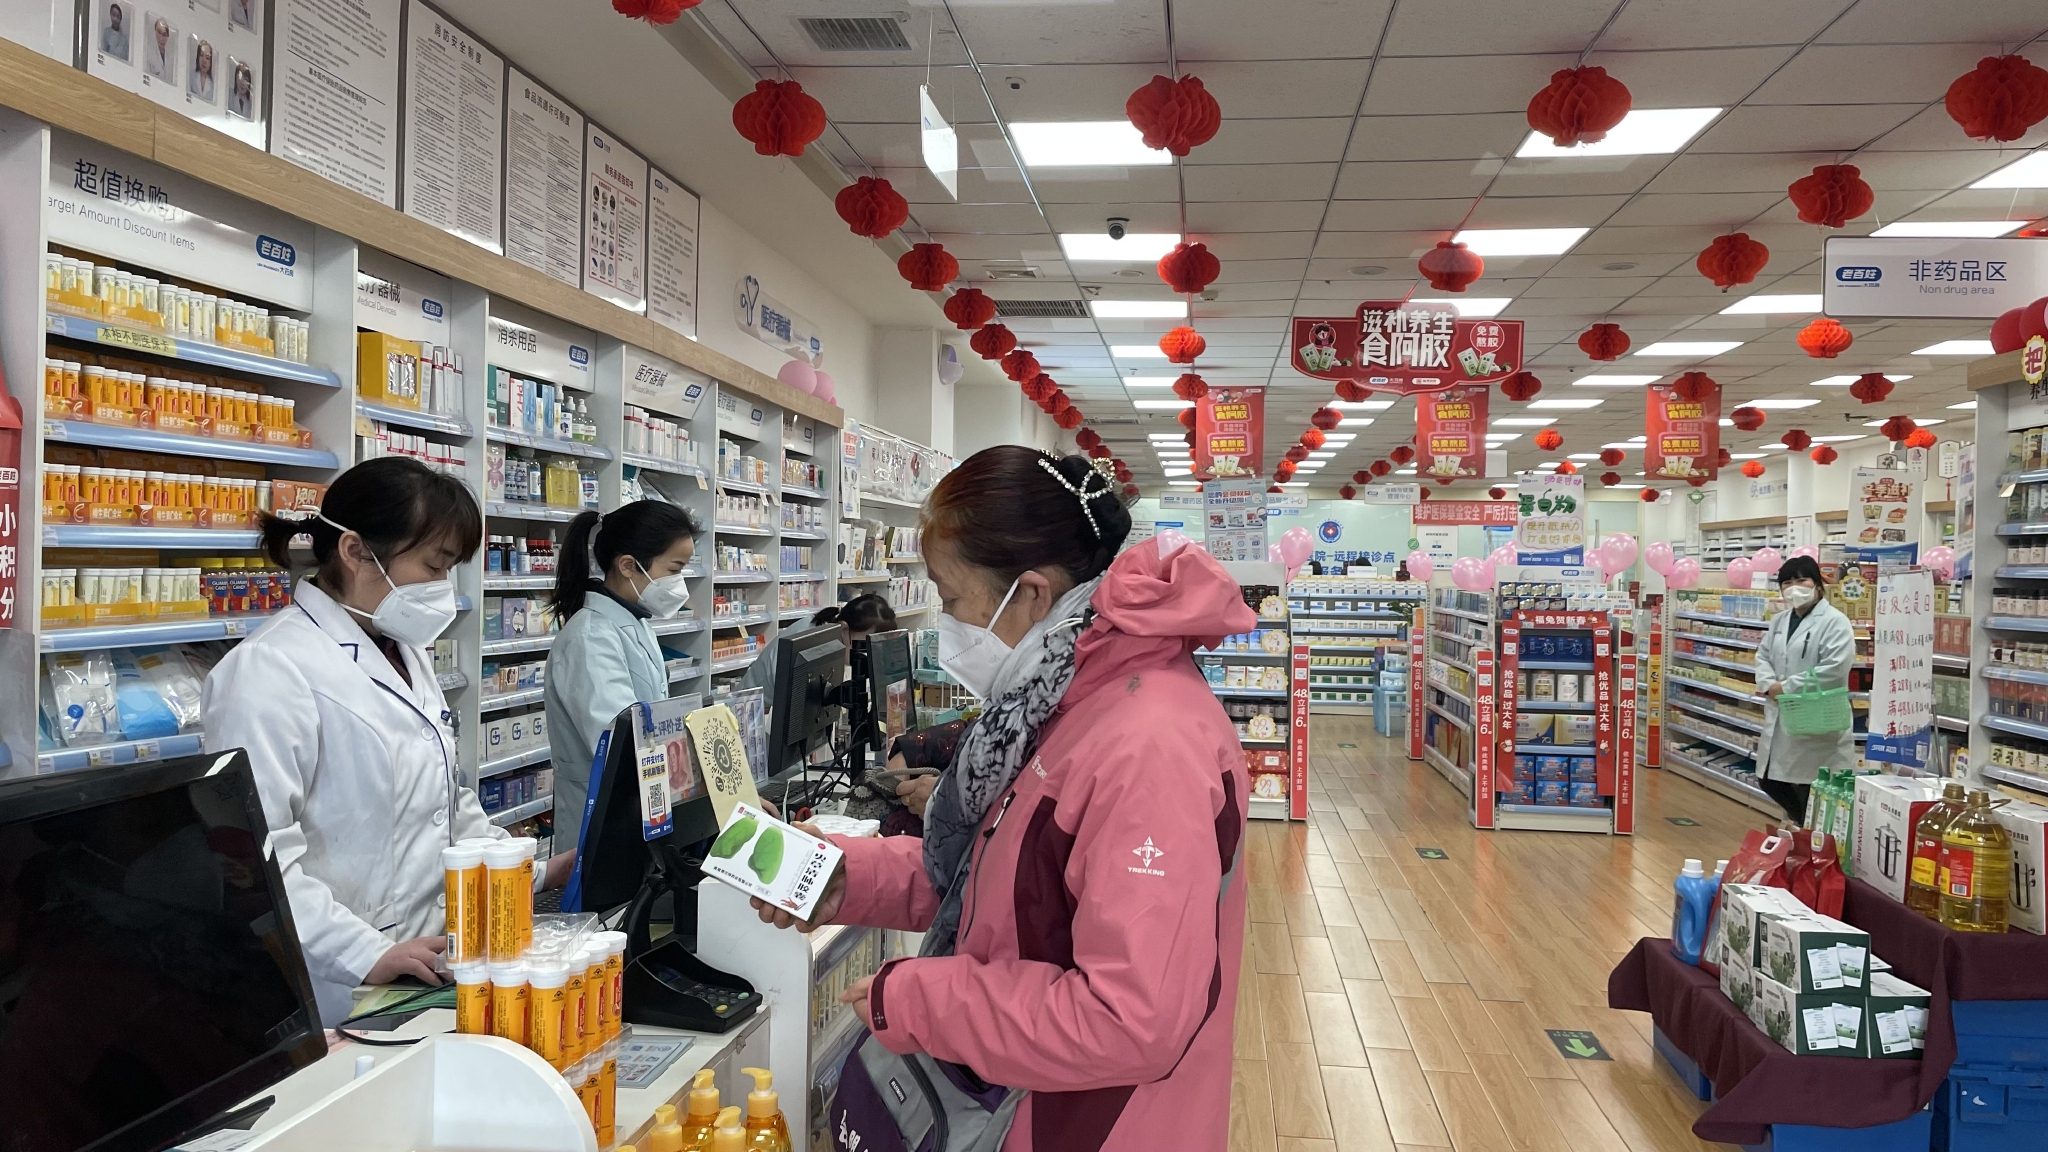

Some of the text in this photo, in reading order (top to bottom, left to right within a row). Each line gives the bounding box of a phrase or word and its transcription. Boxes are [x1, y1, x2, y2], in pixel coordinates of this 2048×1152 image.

[74, 158, 168, 217] 超值换购
[48, 197, 196, 251] arget Amount Discount Items
[1841, 268, 1877, 280] 老百姓
[1909, 259, 2008, 282] 非药品区
[1919, 285, 1995, 295] Non drug area
[376, 301, 397, 317] Devices
[1362, 309, 1454, 333] 滋补养生
[1476, 325, 1499, 336] 免费
[102, 326, 170, 352] 本柜不刷医保卡
[497, 323, 537, 354] 消杀用品
[1360, 332, 1452, 367] 食阿胶
[1414, 503, 1517, 521] 维护医保基金安全 严厉打击
[1518, 488, 1578, 516] 蛋白粉
[1877, 590, 1931, 615] 超级会员日
[1535, 615, 1586, 625] 福兔贺新春
[1502, 669, 1514, 730] 抢优品 过大年
[1598, 670, 1610, 733] 抢优品 过大年
[1481, 705, 1491, 723] 立减
[1623, 709, 1633, 727] 立减
[641, 753, 665, 767] 打开支付宝
[1856, 808, 1865, 865] COOKWARE
[1127, 866, 1165, 877] TREKKING
